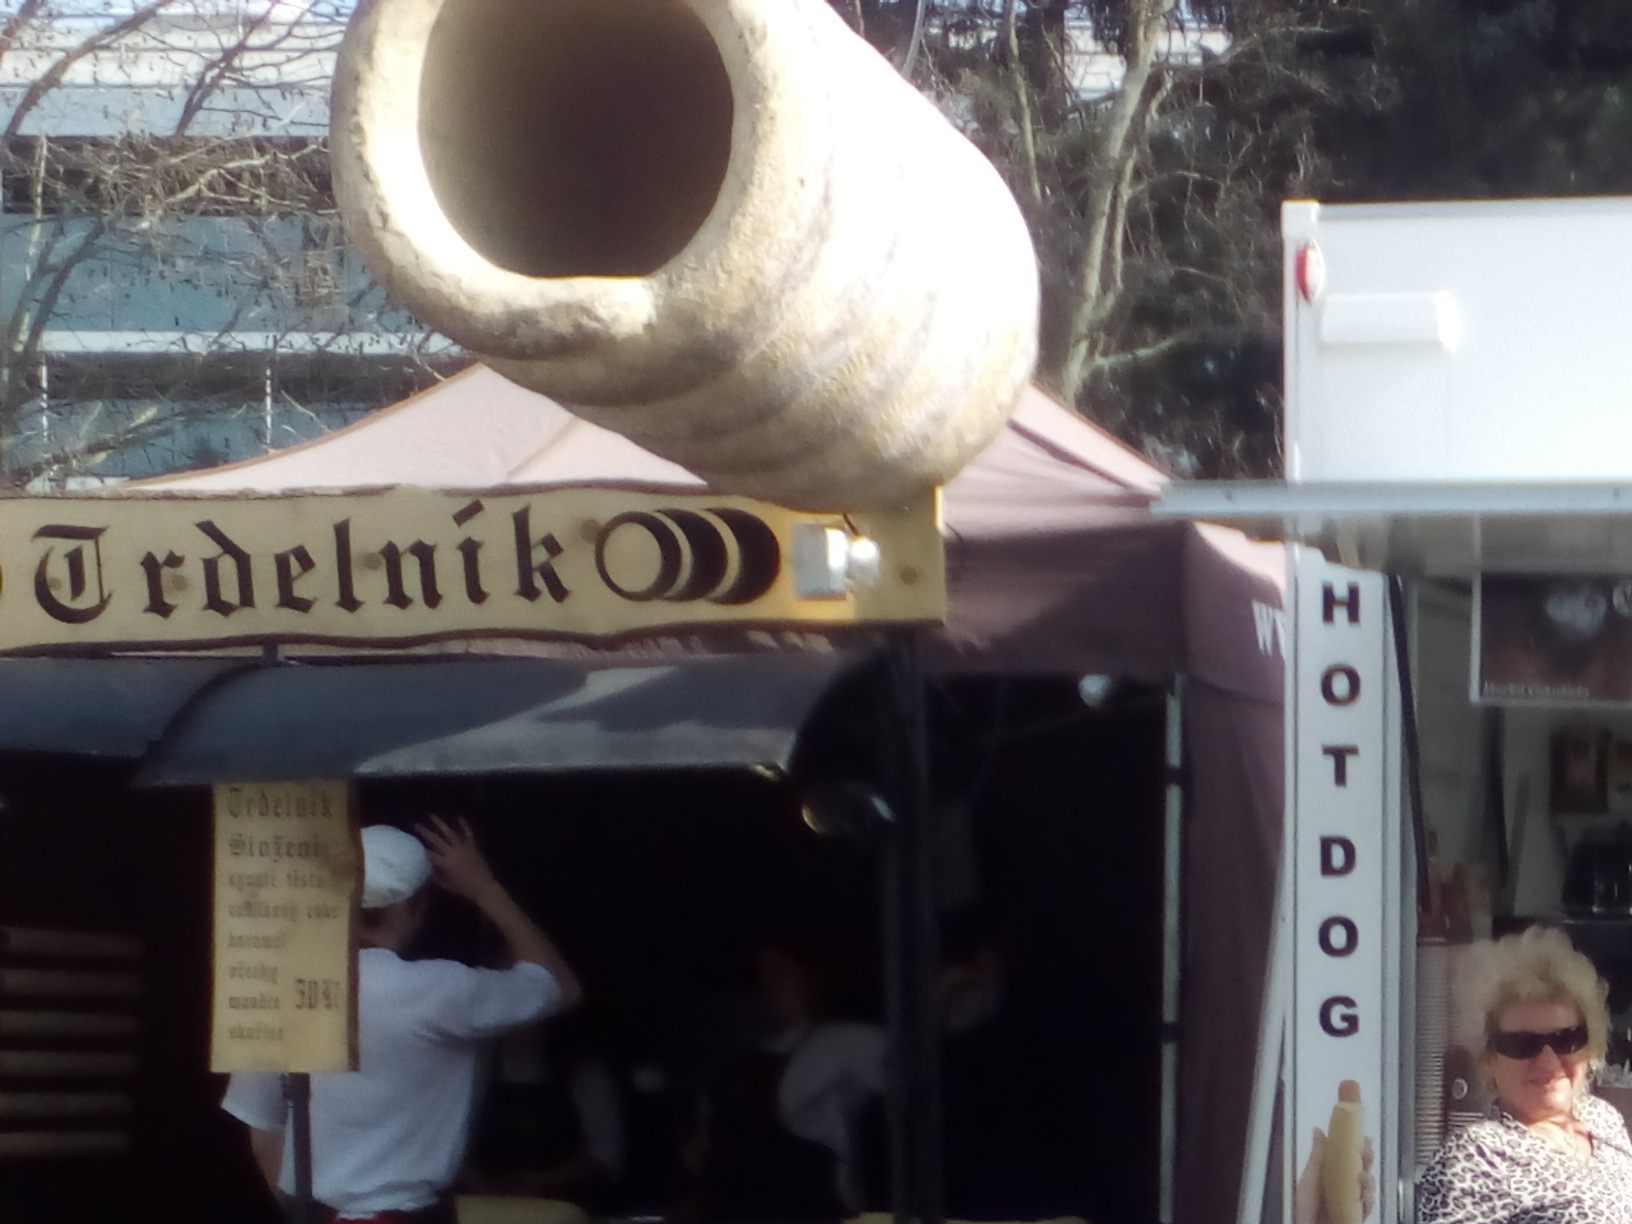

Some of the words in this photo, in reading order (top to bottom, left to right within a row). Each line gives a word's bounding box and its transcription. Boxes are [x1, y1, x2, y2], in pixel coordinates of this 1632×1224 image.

[32, 499, 573, 624] Trdelník
[1320, 582, 1361, 788] HOT
[1318, 835, 1359, 1038] DOG
